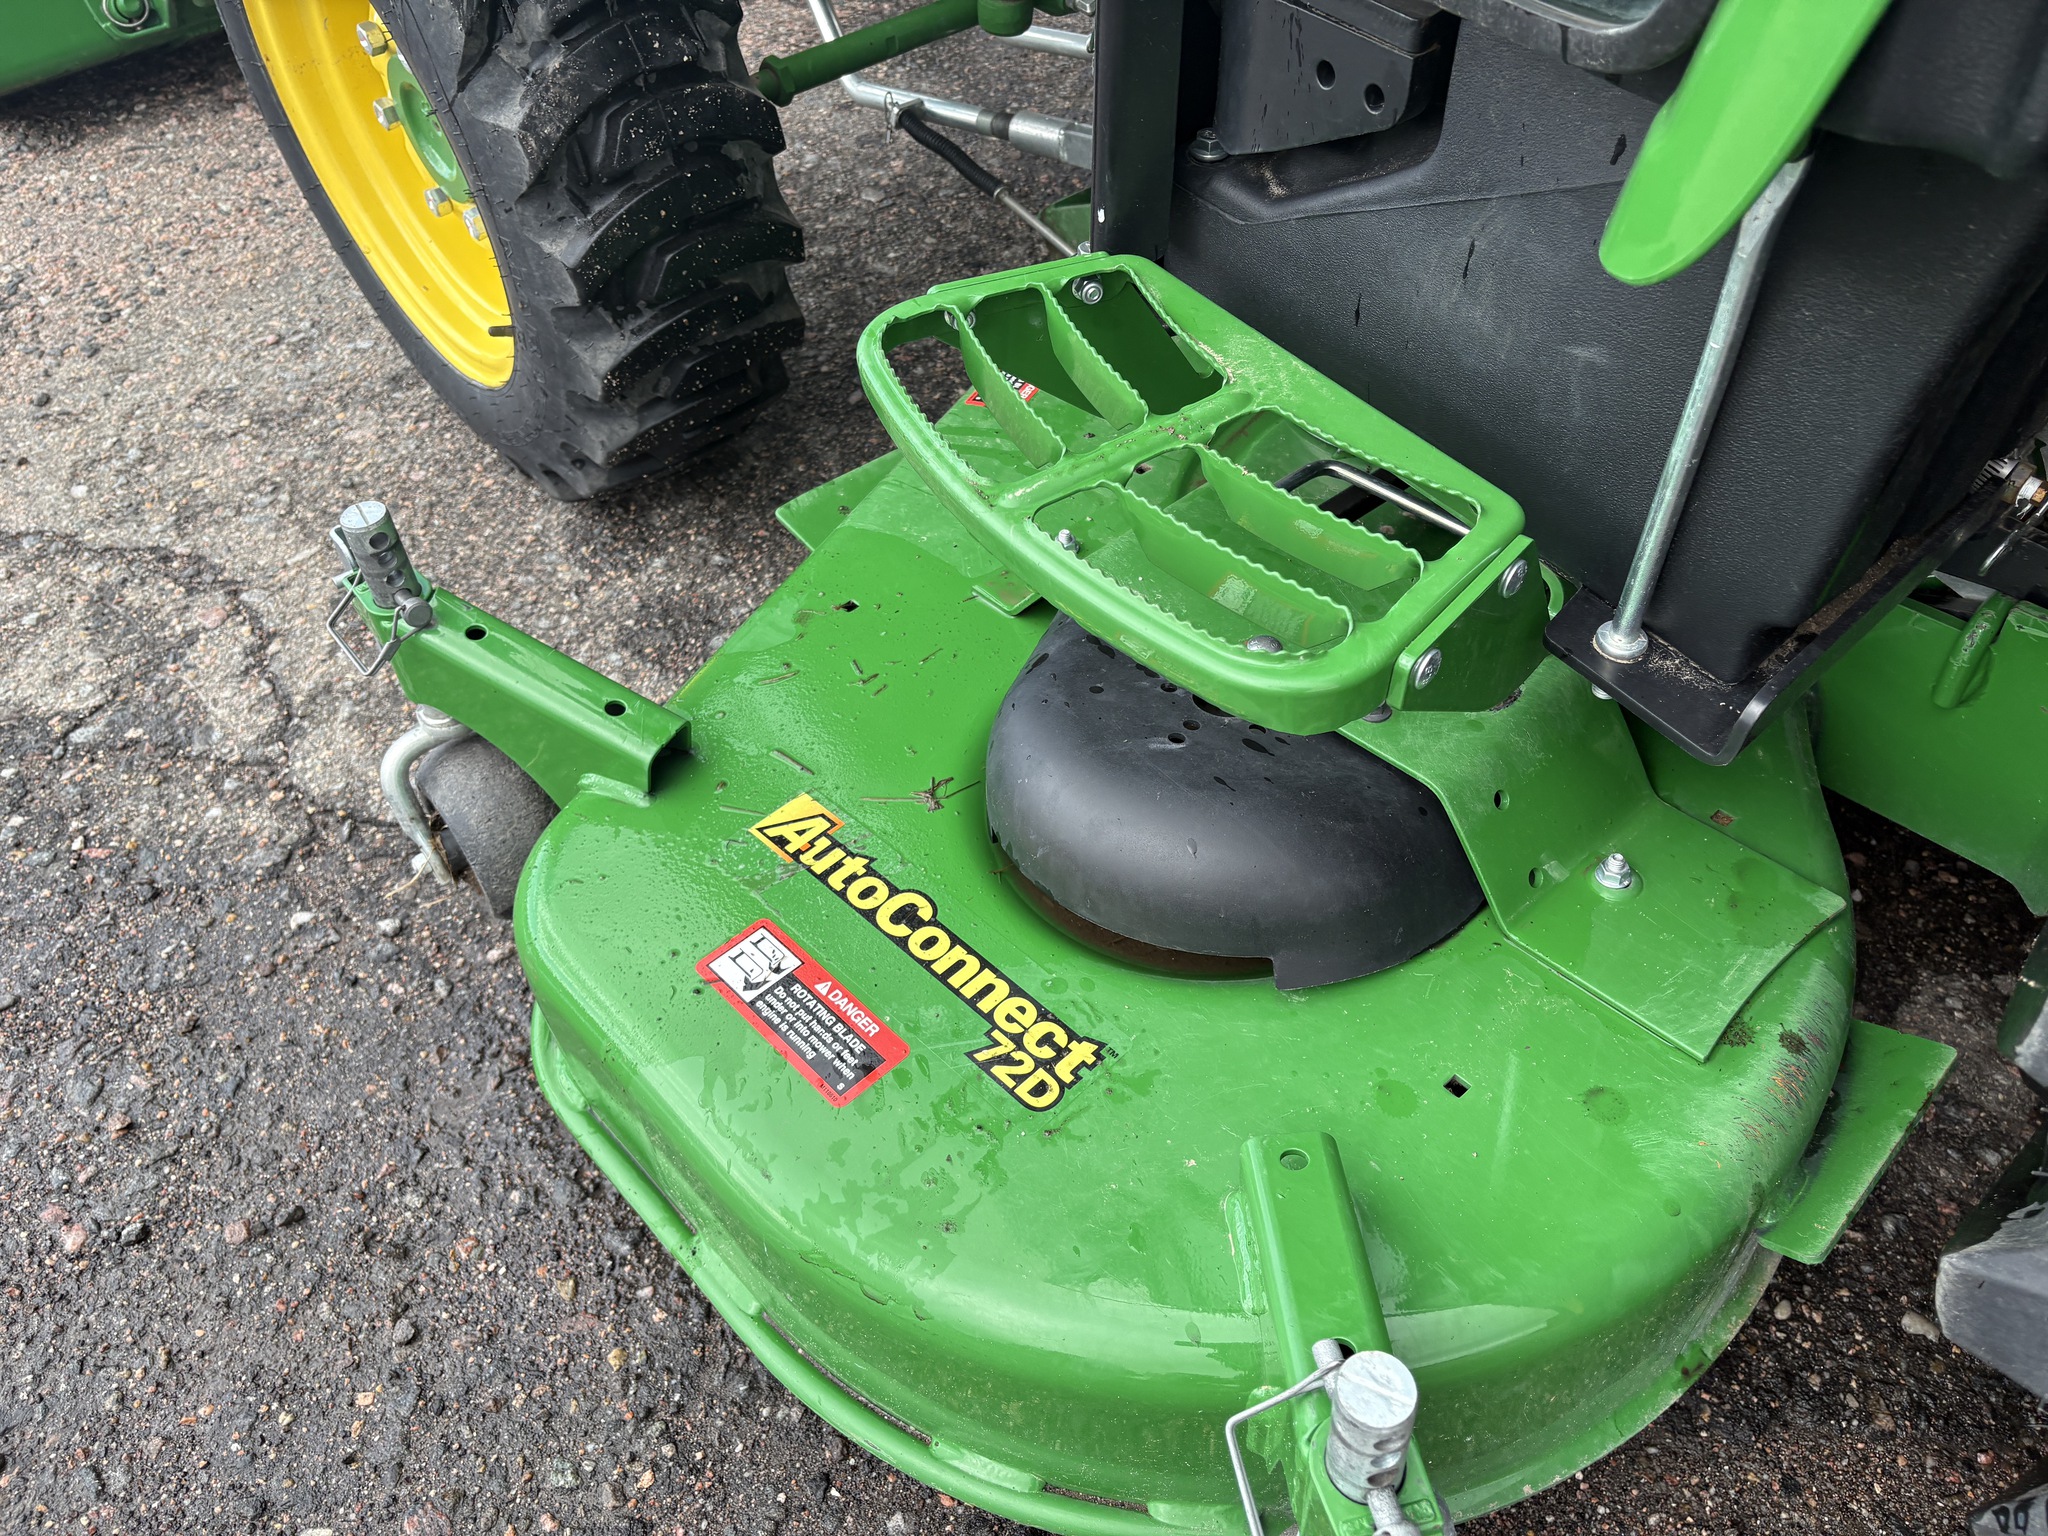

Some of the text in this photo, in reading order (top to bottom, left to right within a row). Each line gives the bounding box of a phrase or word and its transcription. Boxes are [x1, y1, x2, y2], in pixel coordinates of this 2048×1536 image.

[762, 813, 1100, 1084] AutoConnect
[755, 1000, 817, 1060] engine is running
[764, 993, 855, 1081] under or into mower when
[773, 985, 859, 1067] Do not put hands or feet
[790, 983, 867, 1055] ROTATING BLADE
[828, 988, 880, 1037] DANGER
[973, 1029, 1061, 1109] 72D
